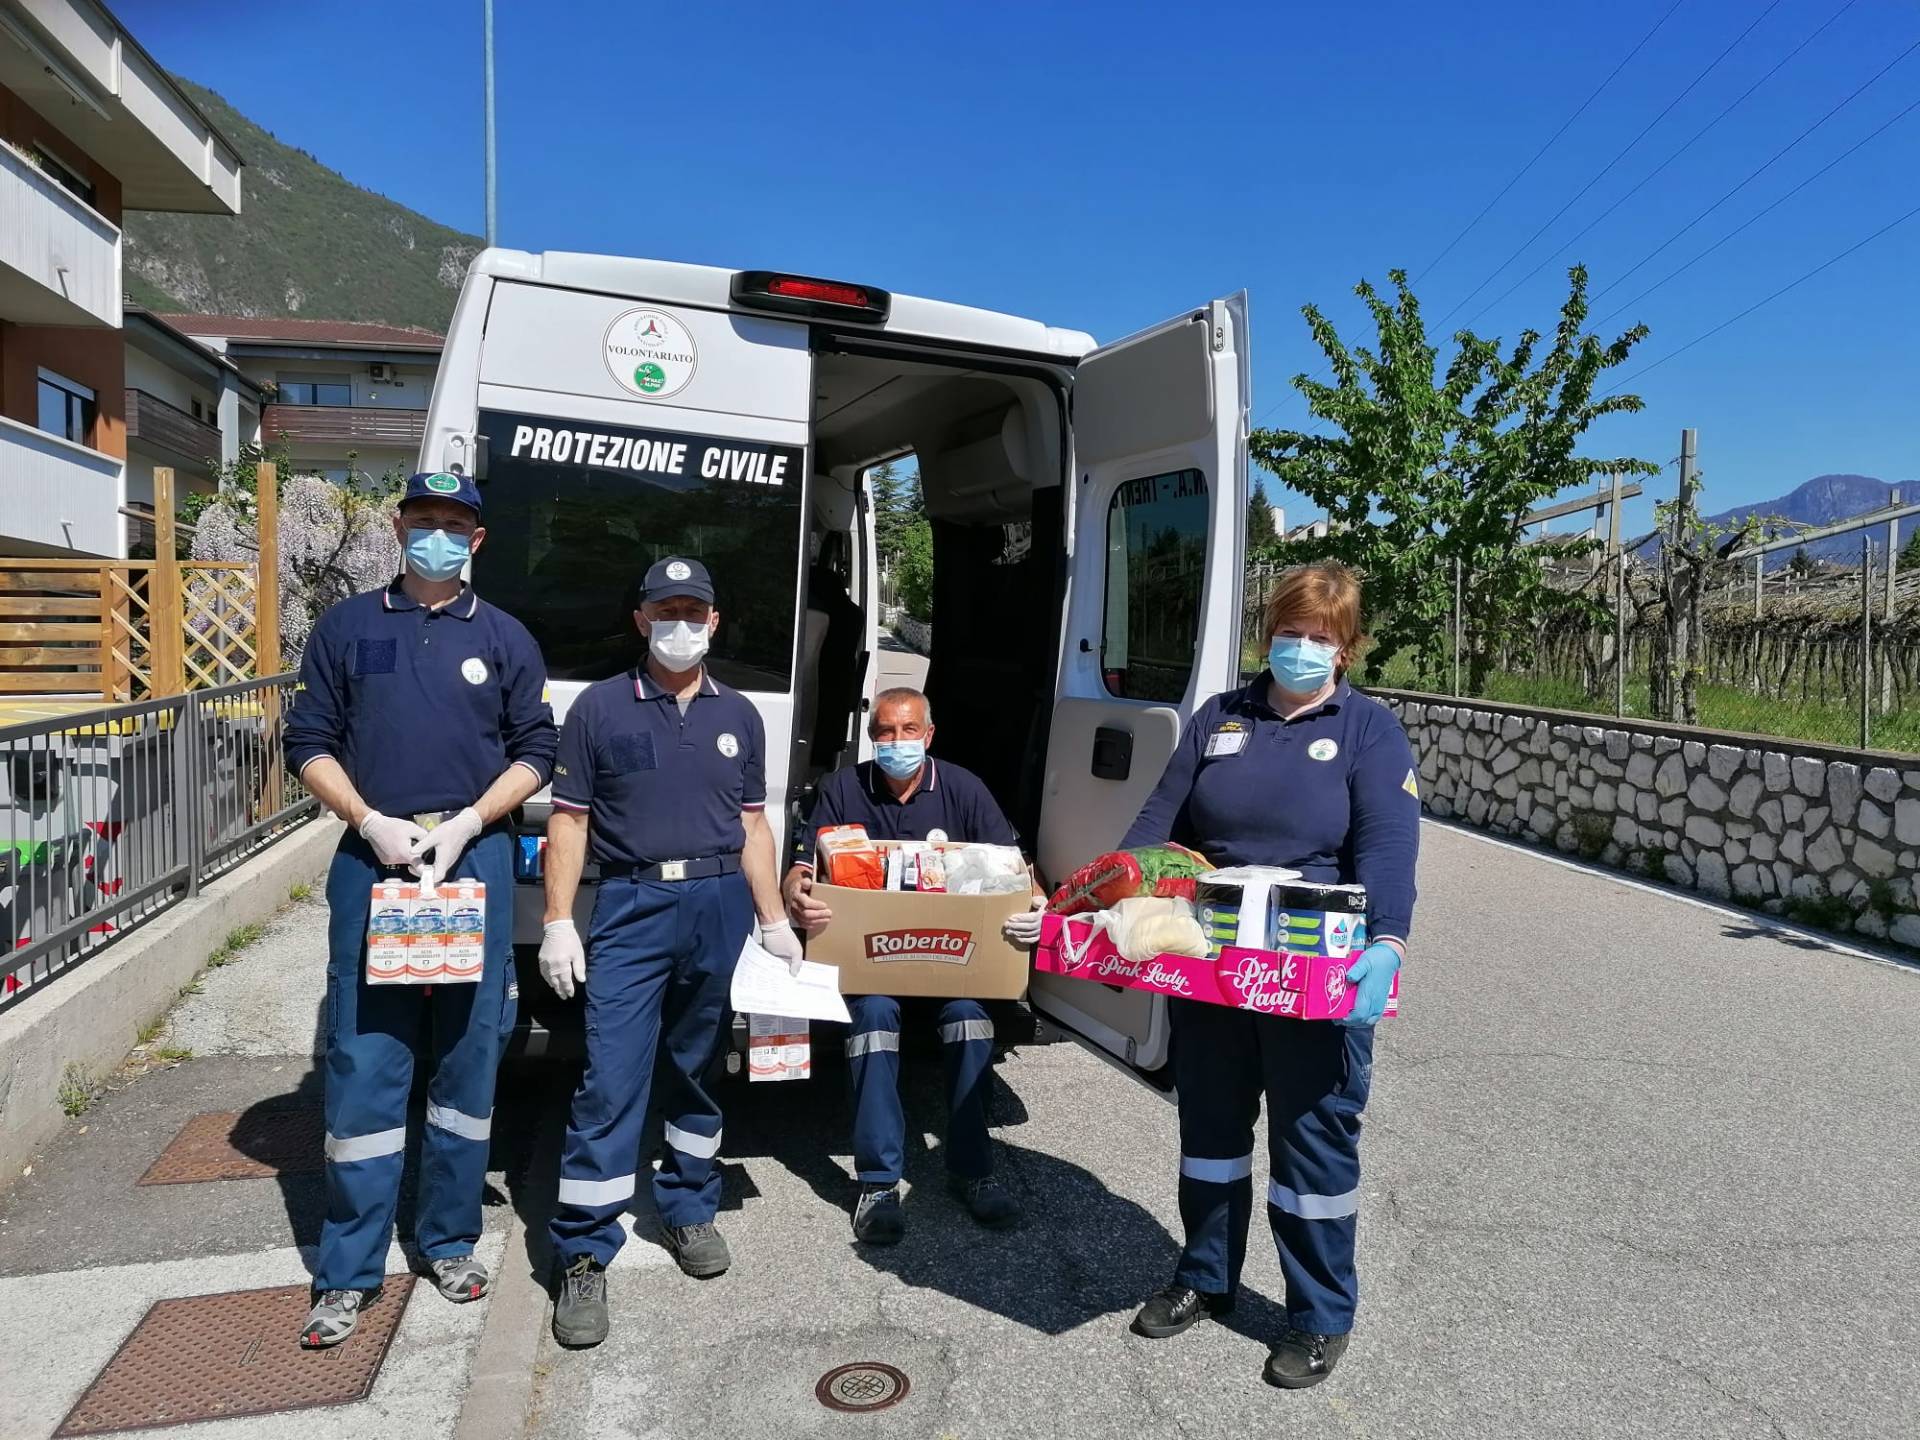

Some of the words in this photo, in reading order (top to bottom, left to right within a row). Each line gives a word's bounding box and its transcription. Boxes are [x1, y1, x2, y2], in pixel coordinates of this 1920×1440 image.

[608, 344, 693, 364] VOLONTARIATO
[511, 425, 687, 474] PROTEZIONE
[701, 447, 787, 485] CIVILE
[872, 933, 963, 954] Roberto
[1087, 954, 1142, 978] Pink
[1142, 962, 1192, 995] Lady
[1218, 953, 1297, 989] Pink
[1239, 981, 1298, 1014] Lady
